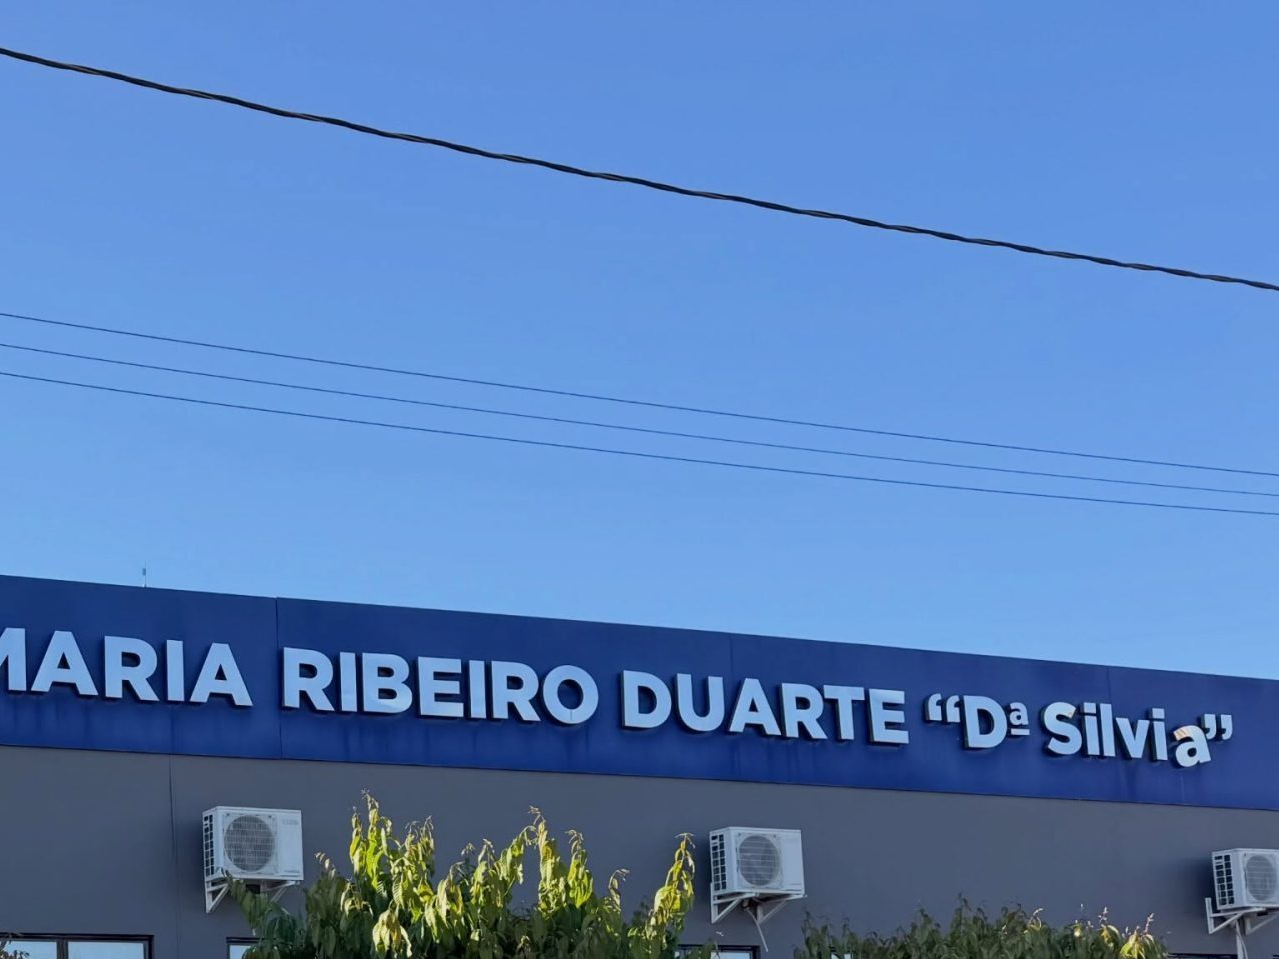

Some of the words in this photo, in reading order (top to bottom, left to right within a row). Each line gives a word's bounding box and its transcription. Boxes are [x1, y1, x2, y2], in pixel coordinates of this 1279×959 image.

[284, 647, 599, 726] RIBEIRO
[624, 670, 910, 745] DUARTE
[1042, 701, 1234, 768] Silvia”
